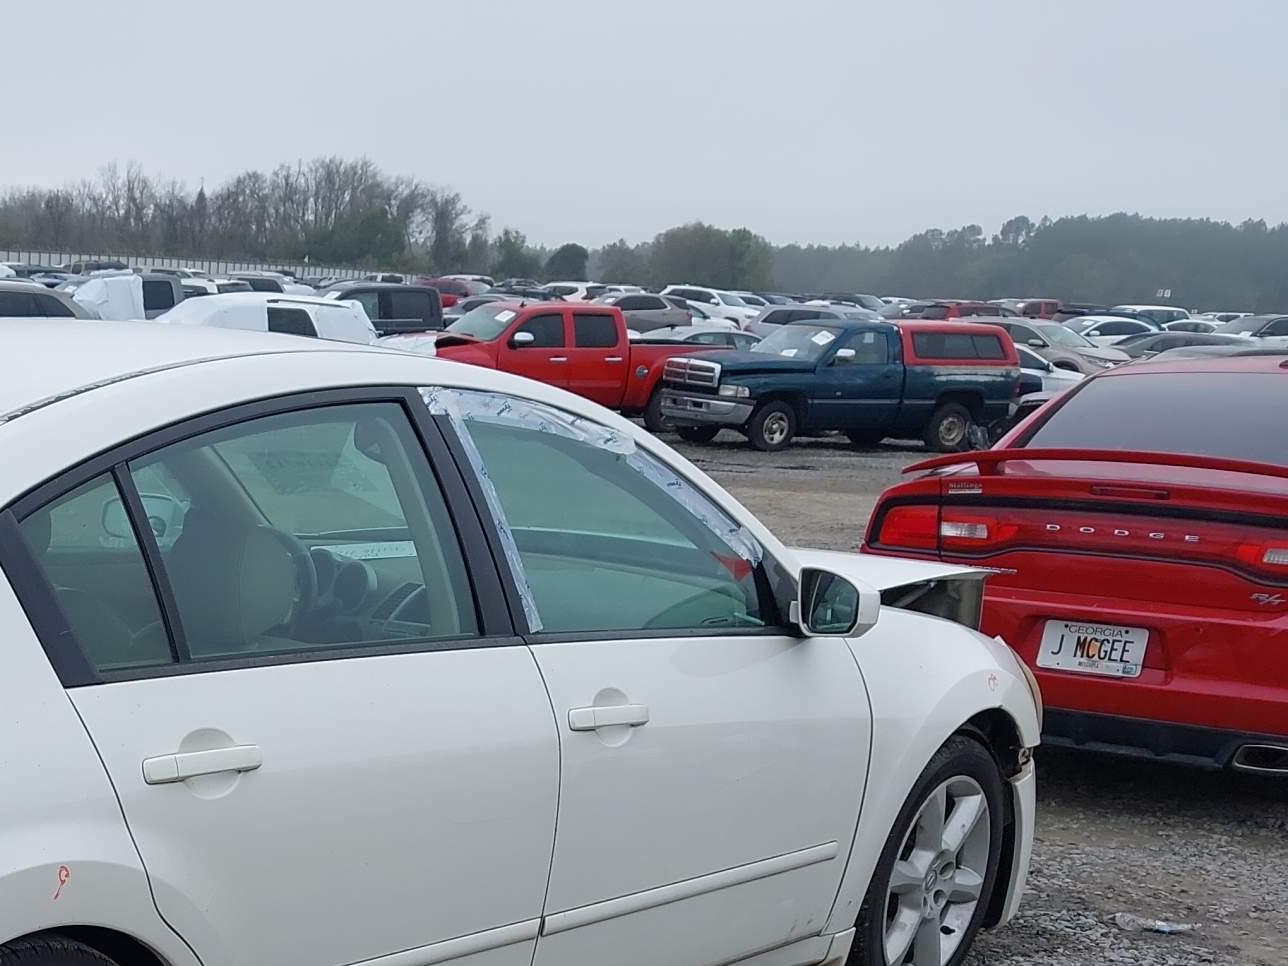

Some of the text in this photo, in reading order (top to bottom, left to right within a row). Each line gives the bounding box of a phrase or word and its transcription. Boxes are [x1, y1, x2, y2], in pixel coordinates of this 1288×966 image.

[1045, 523, 1200, 543] DODGE
[1248, 592, 1287, 606] R/T
[1068, 624, 1124, 639] GEORGIA
[1050, 633, 1135, 664] J MCGEE
